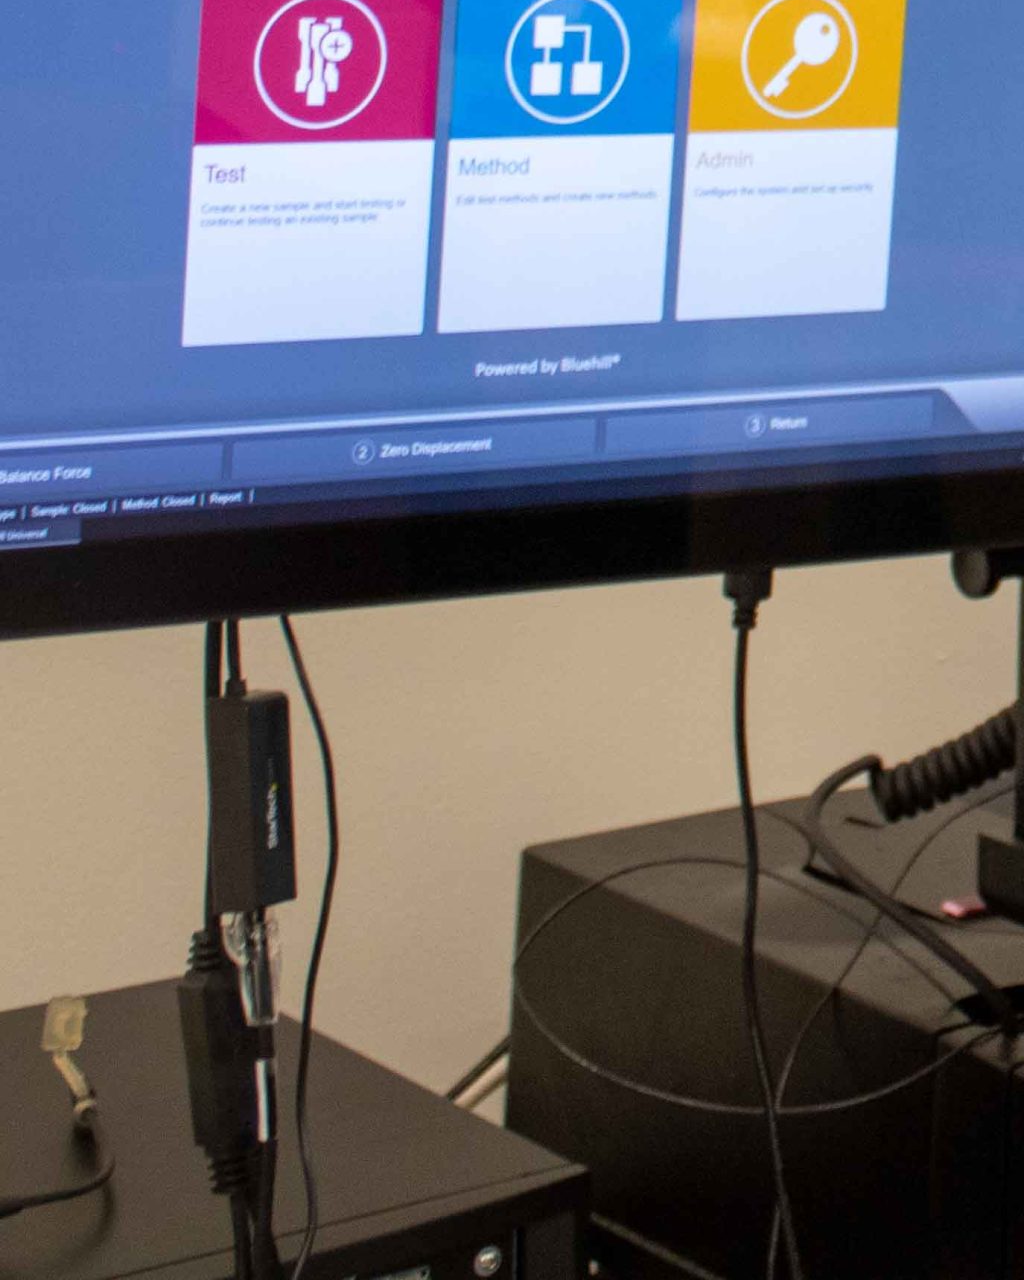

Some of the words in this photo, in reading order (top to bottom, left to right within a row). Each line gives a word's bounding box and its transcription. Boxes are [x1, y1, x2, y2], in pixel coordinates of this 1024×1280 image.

[458, 157, 530, 176] Method
[695, 151, 753, 169] Admin
[204, 164, 247, 184] Test
[475, 360, 539, 376] Powered
[540, 358, 559, 375] by
[380, 443, 409, 458] Zero
[411, 436, 492, 457] Displacement
[54, 466, 92, 480] Force
